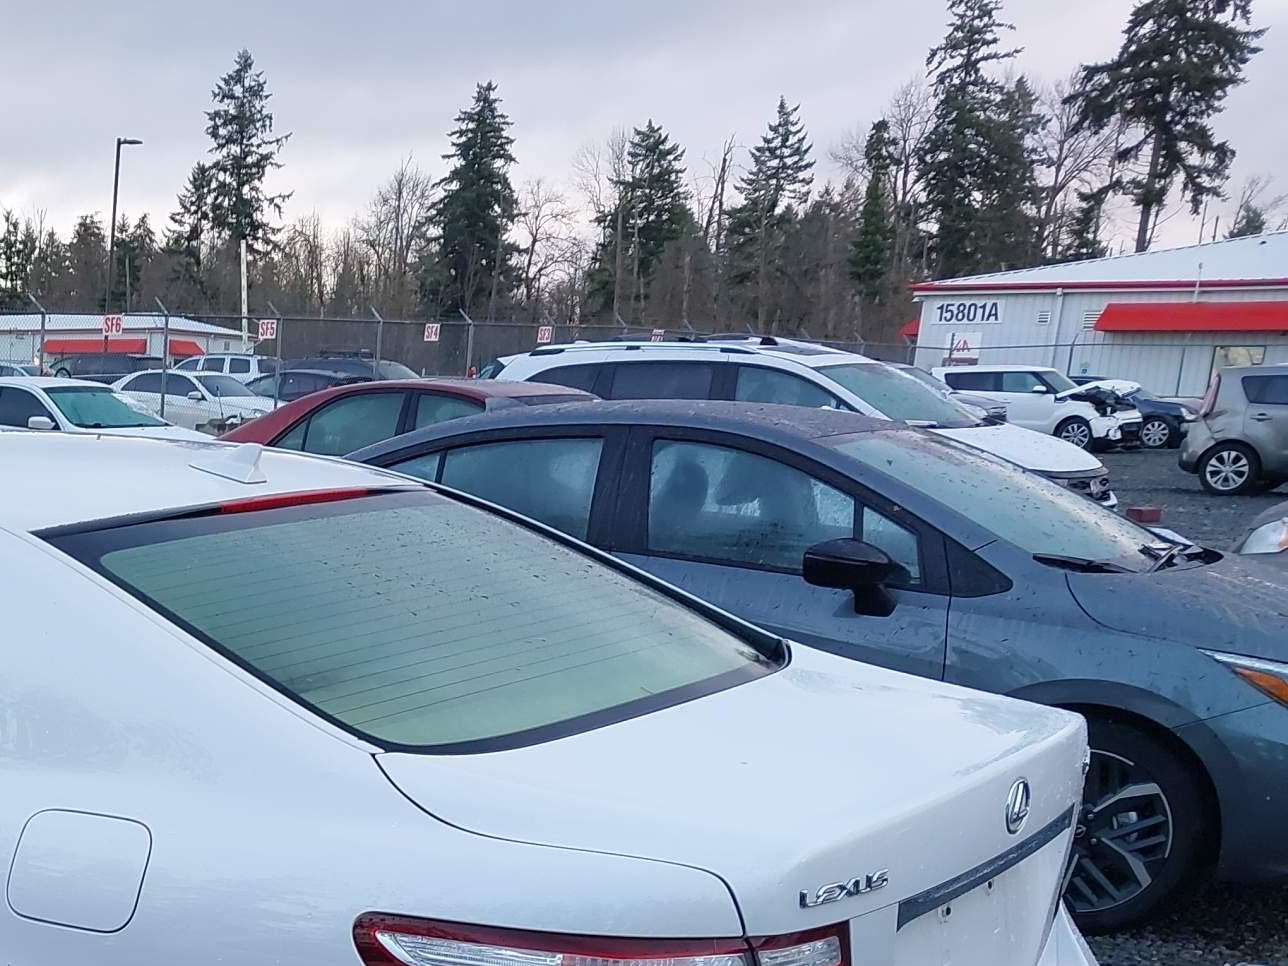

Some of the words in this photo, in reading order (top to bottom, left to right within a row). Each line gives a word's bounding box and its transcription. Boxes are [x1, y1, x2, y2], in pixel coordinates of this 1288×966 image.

[936, 302, 999, 322] 15801A
[104, 316, 121, 333] SF6
[260, 321, 276, 336] SF5
[799, 869, 889, 909] LEXUS
